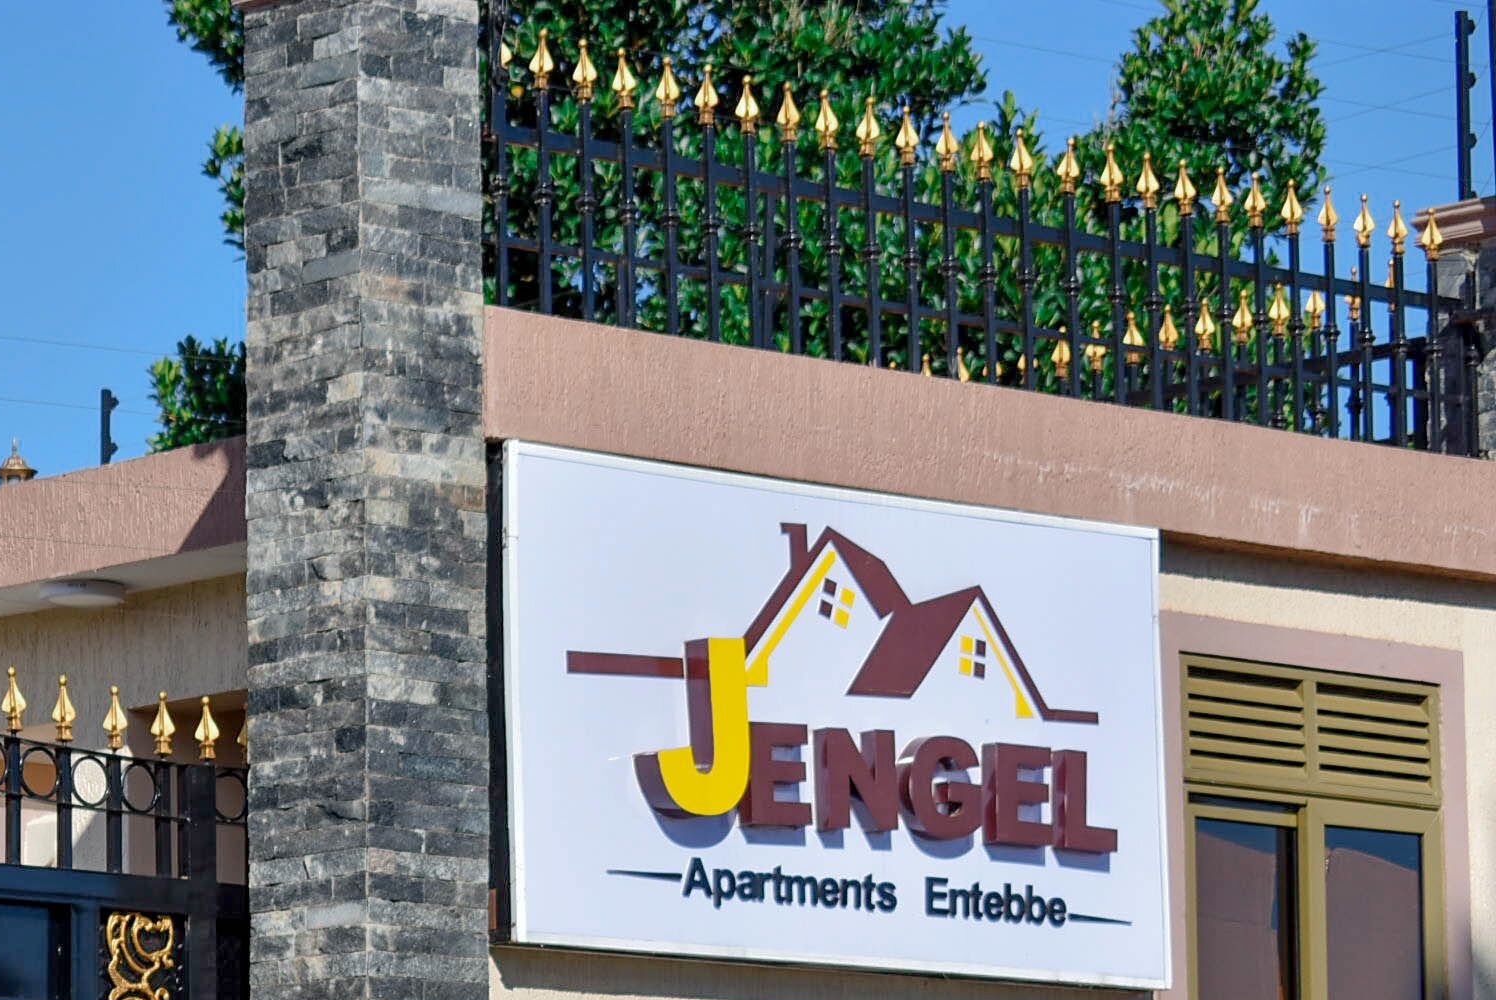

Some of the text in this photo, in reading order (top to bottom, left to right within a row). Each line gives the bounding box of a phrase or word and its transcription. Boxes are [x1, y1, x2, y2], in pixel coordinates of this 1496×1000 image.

[635, 637, 1118, 853] JENGEL
[682, 857, 1067, 927] Apartments Entebbe
